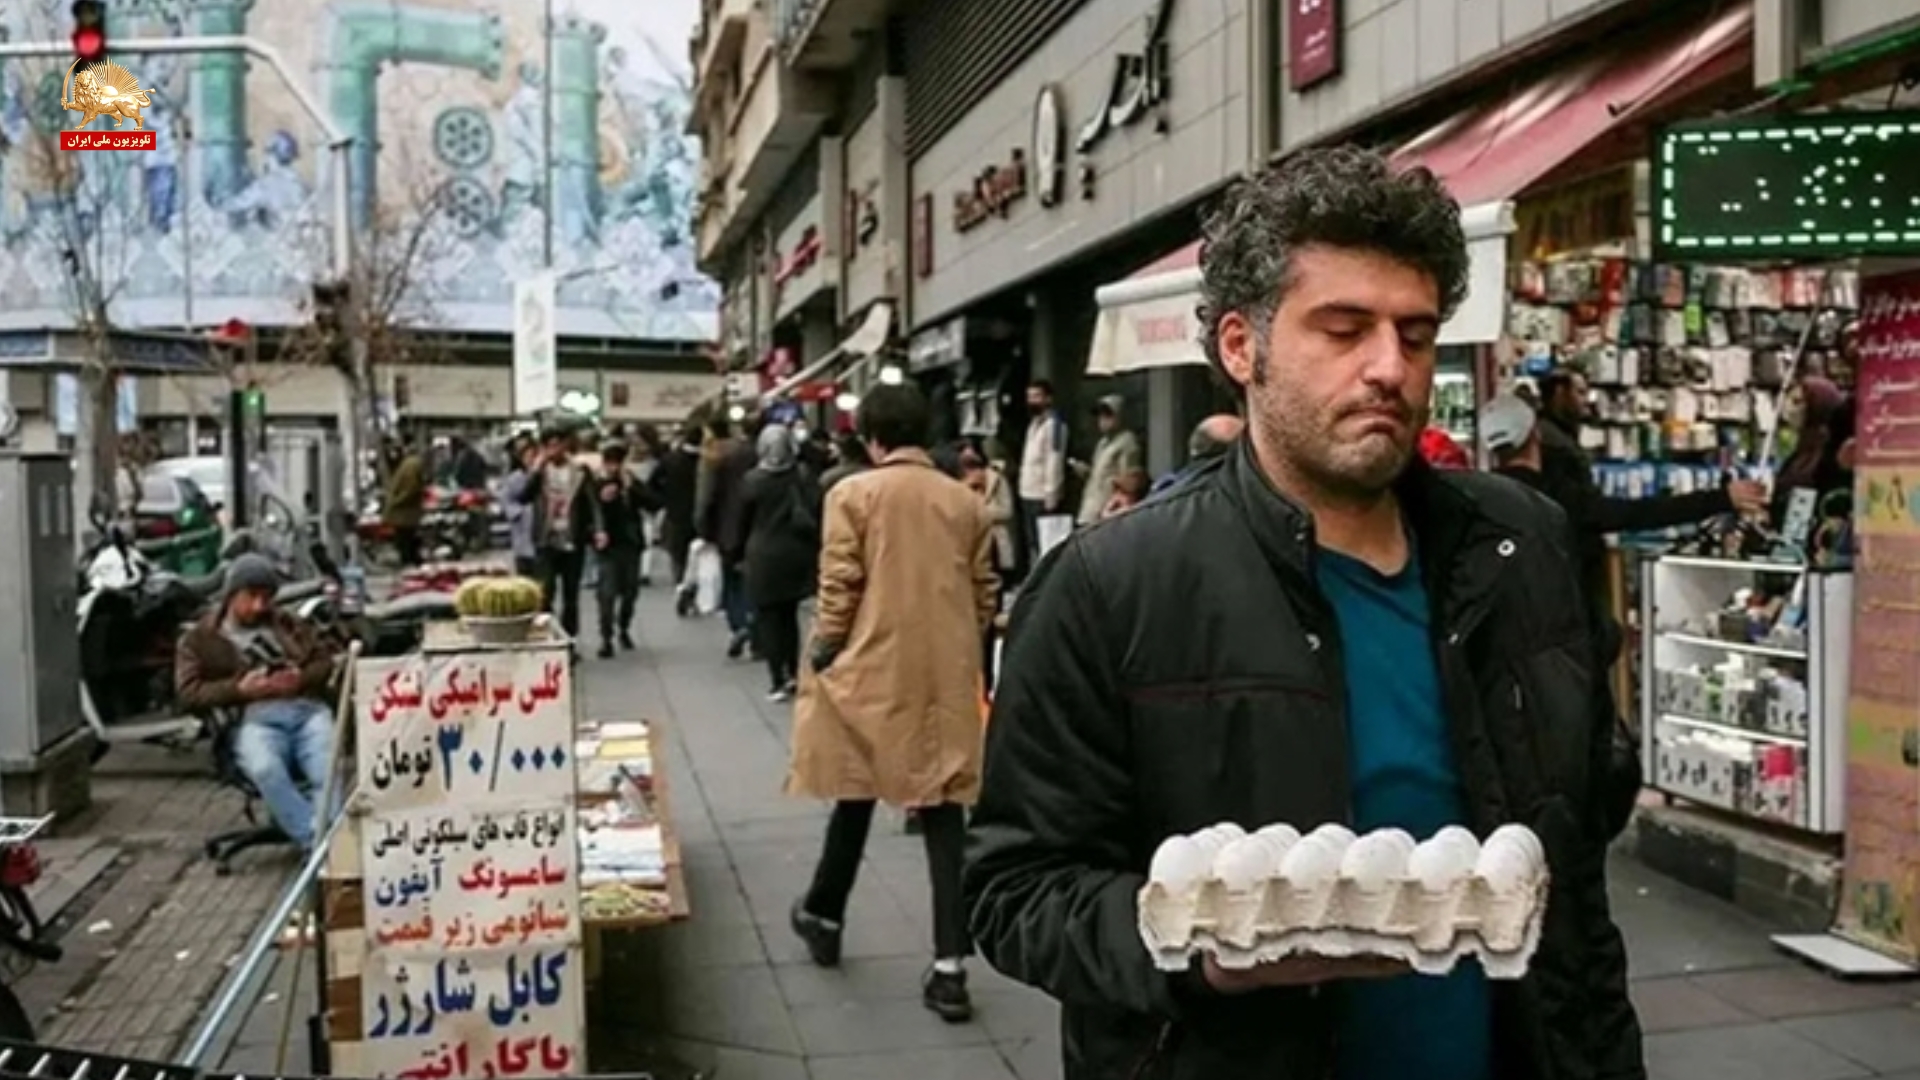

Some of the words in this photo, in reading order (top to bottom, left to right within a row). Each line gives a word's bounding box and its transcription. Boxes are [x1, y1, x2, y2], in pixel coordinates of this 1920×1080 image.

[372, 734, 434, 790] تومان
[503, 809, 528, 848] قاب
[376, 904, 434, 950] قیمت
[443, 911, 475, 948] زیر
[368, 957, 475, 1039] شارژر
[488, 951, 566, 1027] کابل
